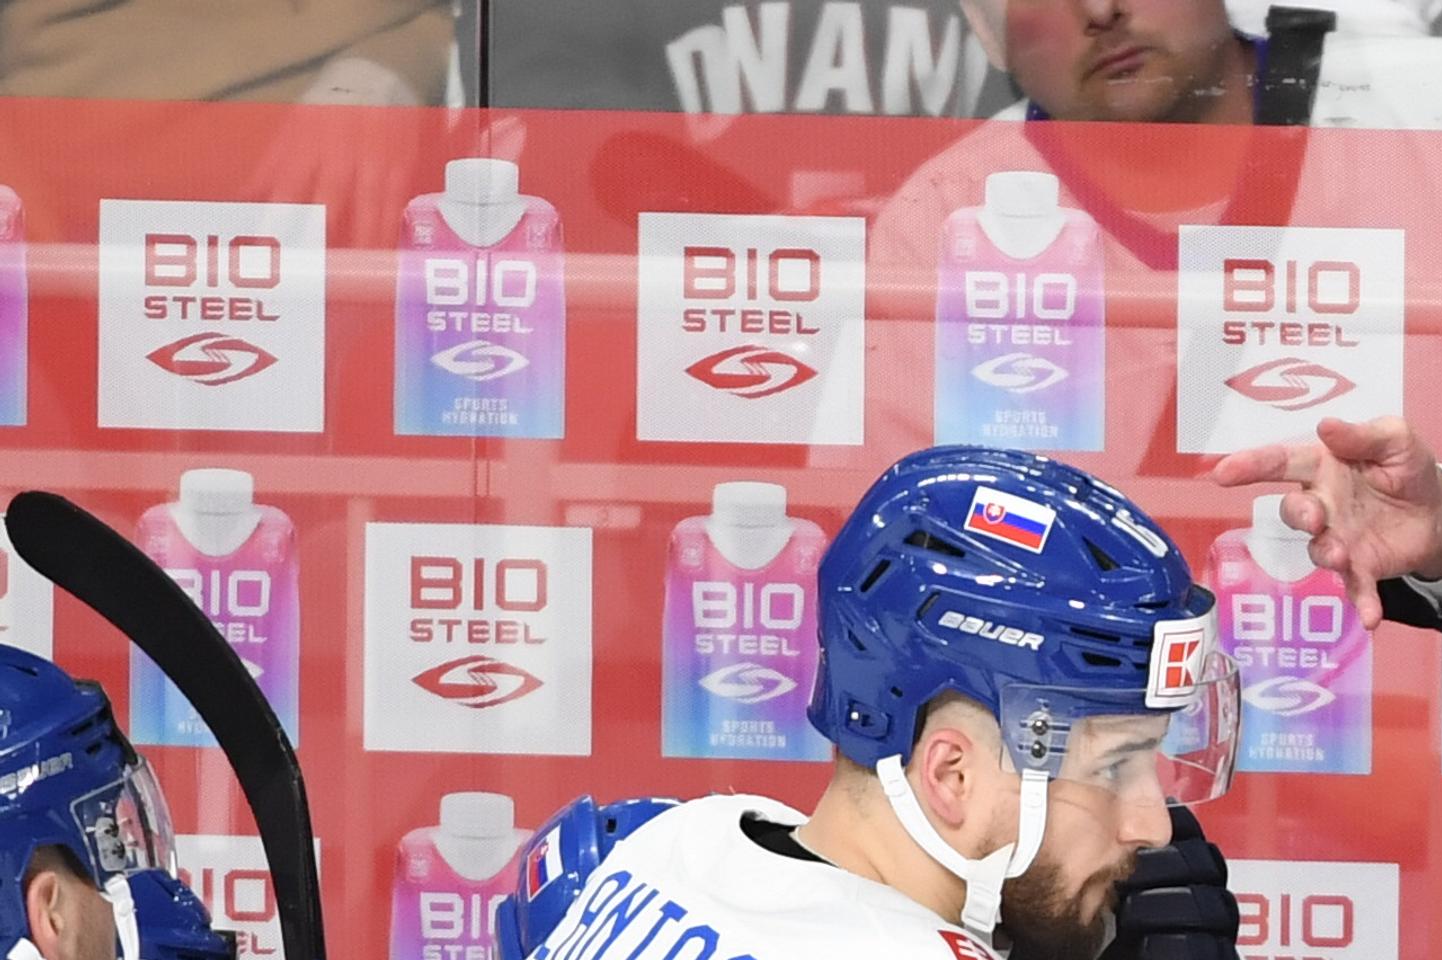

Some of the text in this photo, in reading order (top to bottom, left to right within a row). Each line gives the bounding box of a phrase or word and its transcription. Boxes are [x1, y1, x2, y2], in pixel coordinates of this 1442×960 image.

[145, 234, 281, 288] BIO
[425, 258, 536, 308] BIO
[684, 247, 821, 301] BIO
[145, 297, 280, 321] STEEL
[965, 271, 1077, 319] BIO
[1223, 259, 1360, 314] BIO
[427, 311, 534, 333] STEEL
[683, 309, 820, 334] STEEL
[967, 323, 1072, 345] STEEL
[1223, 322, 1360, 347] STEEL
[410, 556, 547, 612] BIO
[692, 581, 805, 630] BIO
[410, 619, 546, 644] STEEL
[1232, 594, 1343, 643] BIO
[695, 634, 800, 656] STEEL
[1234, 647, 1340, 669] STEEL
[178, 868, 277, 922] IO
